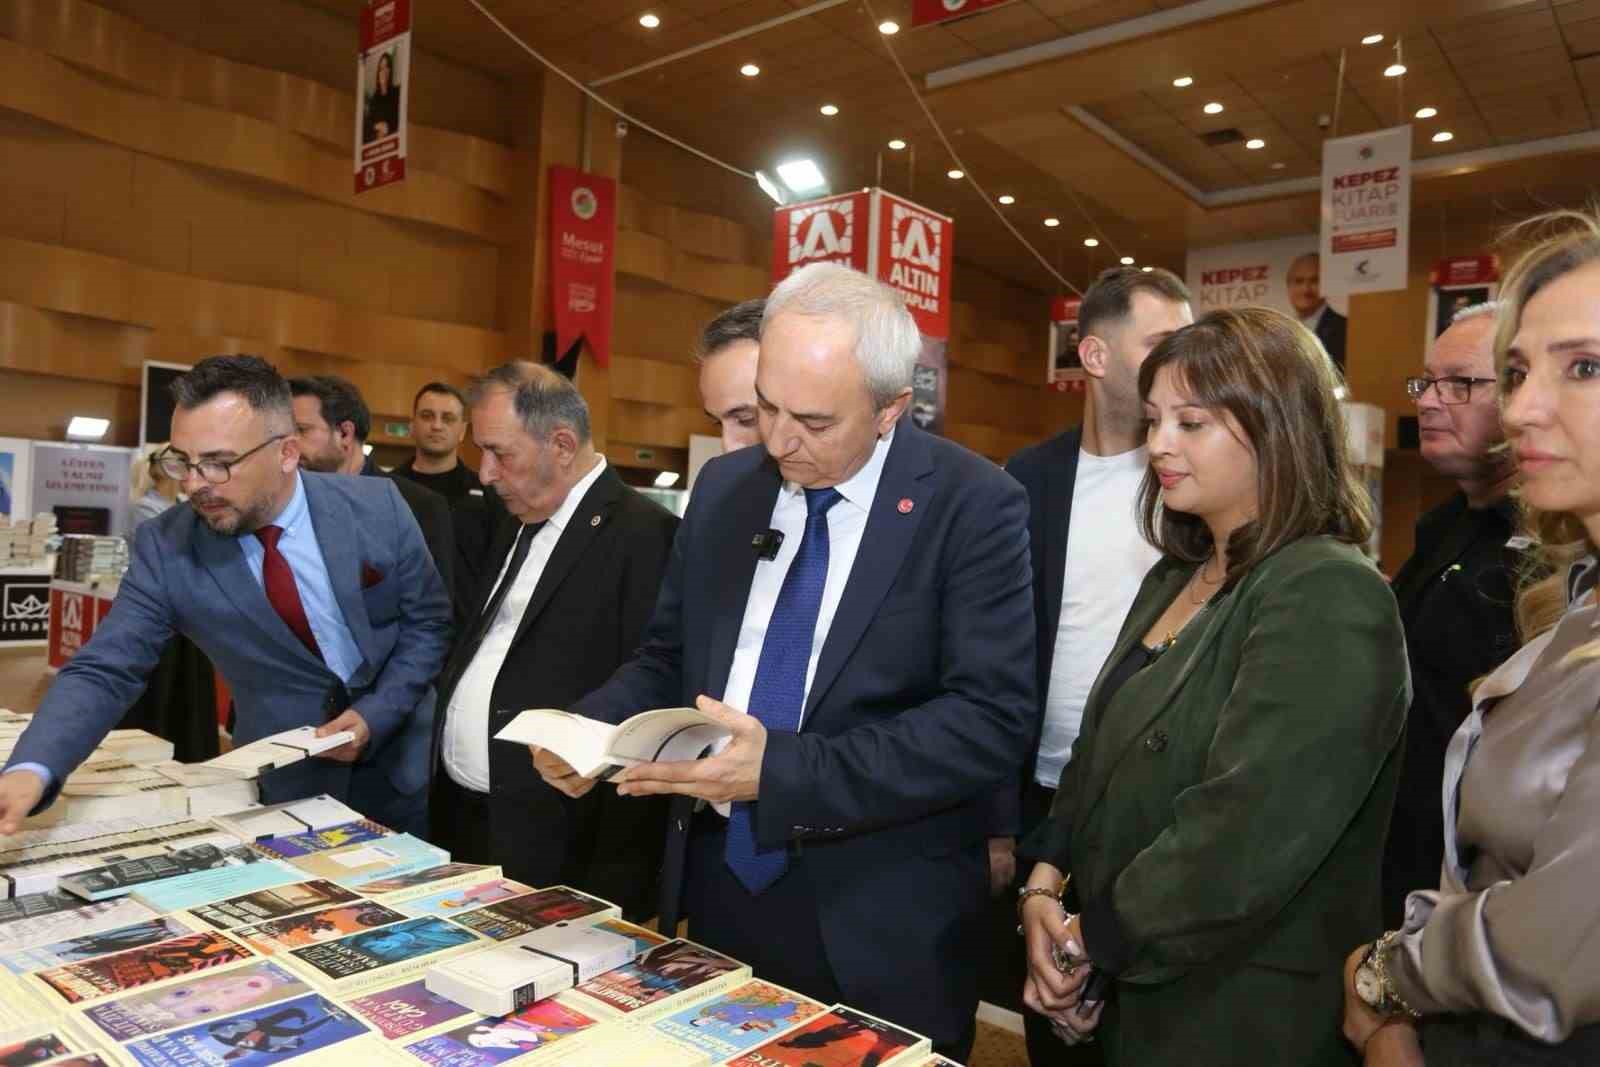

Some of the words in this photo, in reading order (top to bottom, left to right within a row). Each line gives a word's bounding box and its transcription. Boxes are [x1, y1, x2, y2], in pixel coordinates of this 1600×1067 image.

[1332, 165, 1400, 191] KEPEZ
[889, 262, 940, 298] ALTIN
[1200, 265, 1270, 287] KEPEZ
